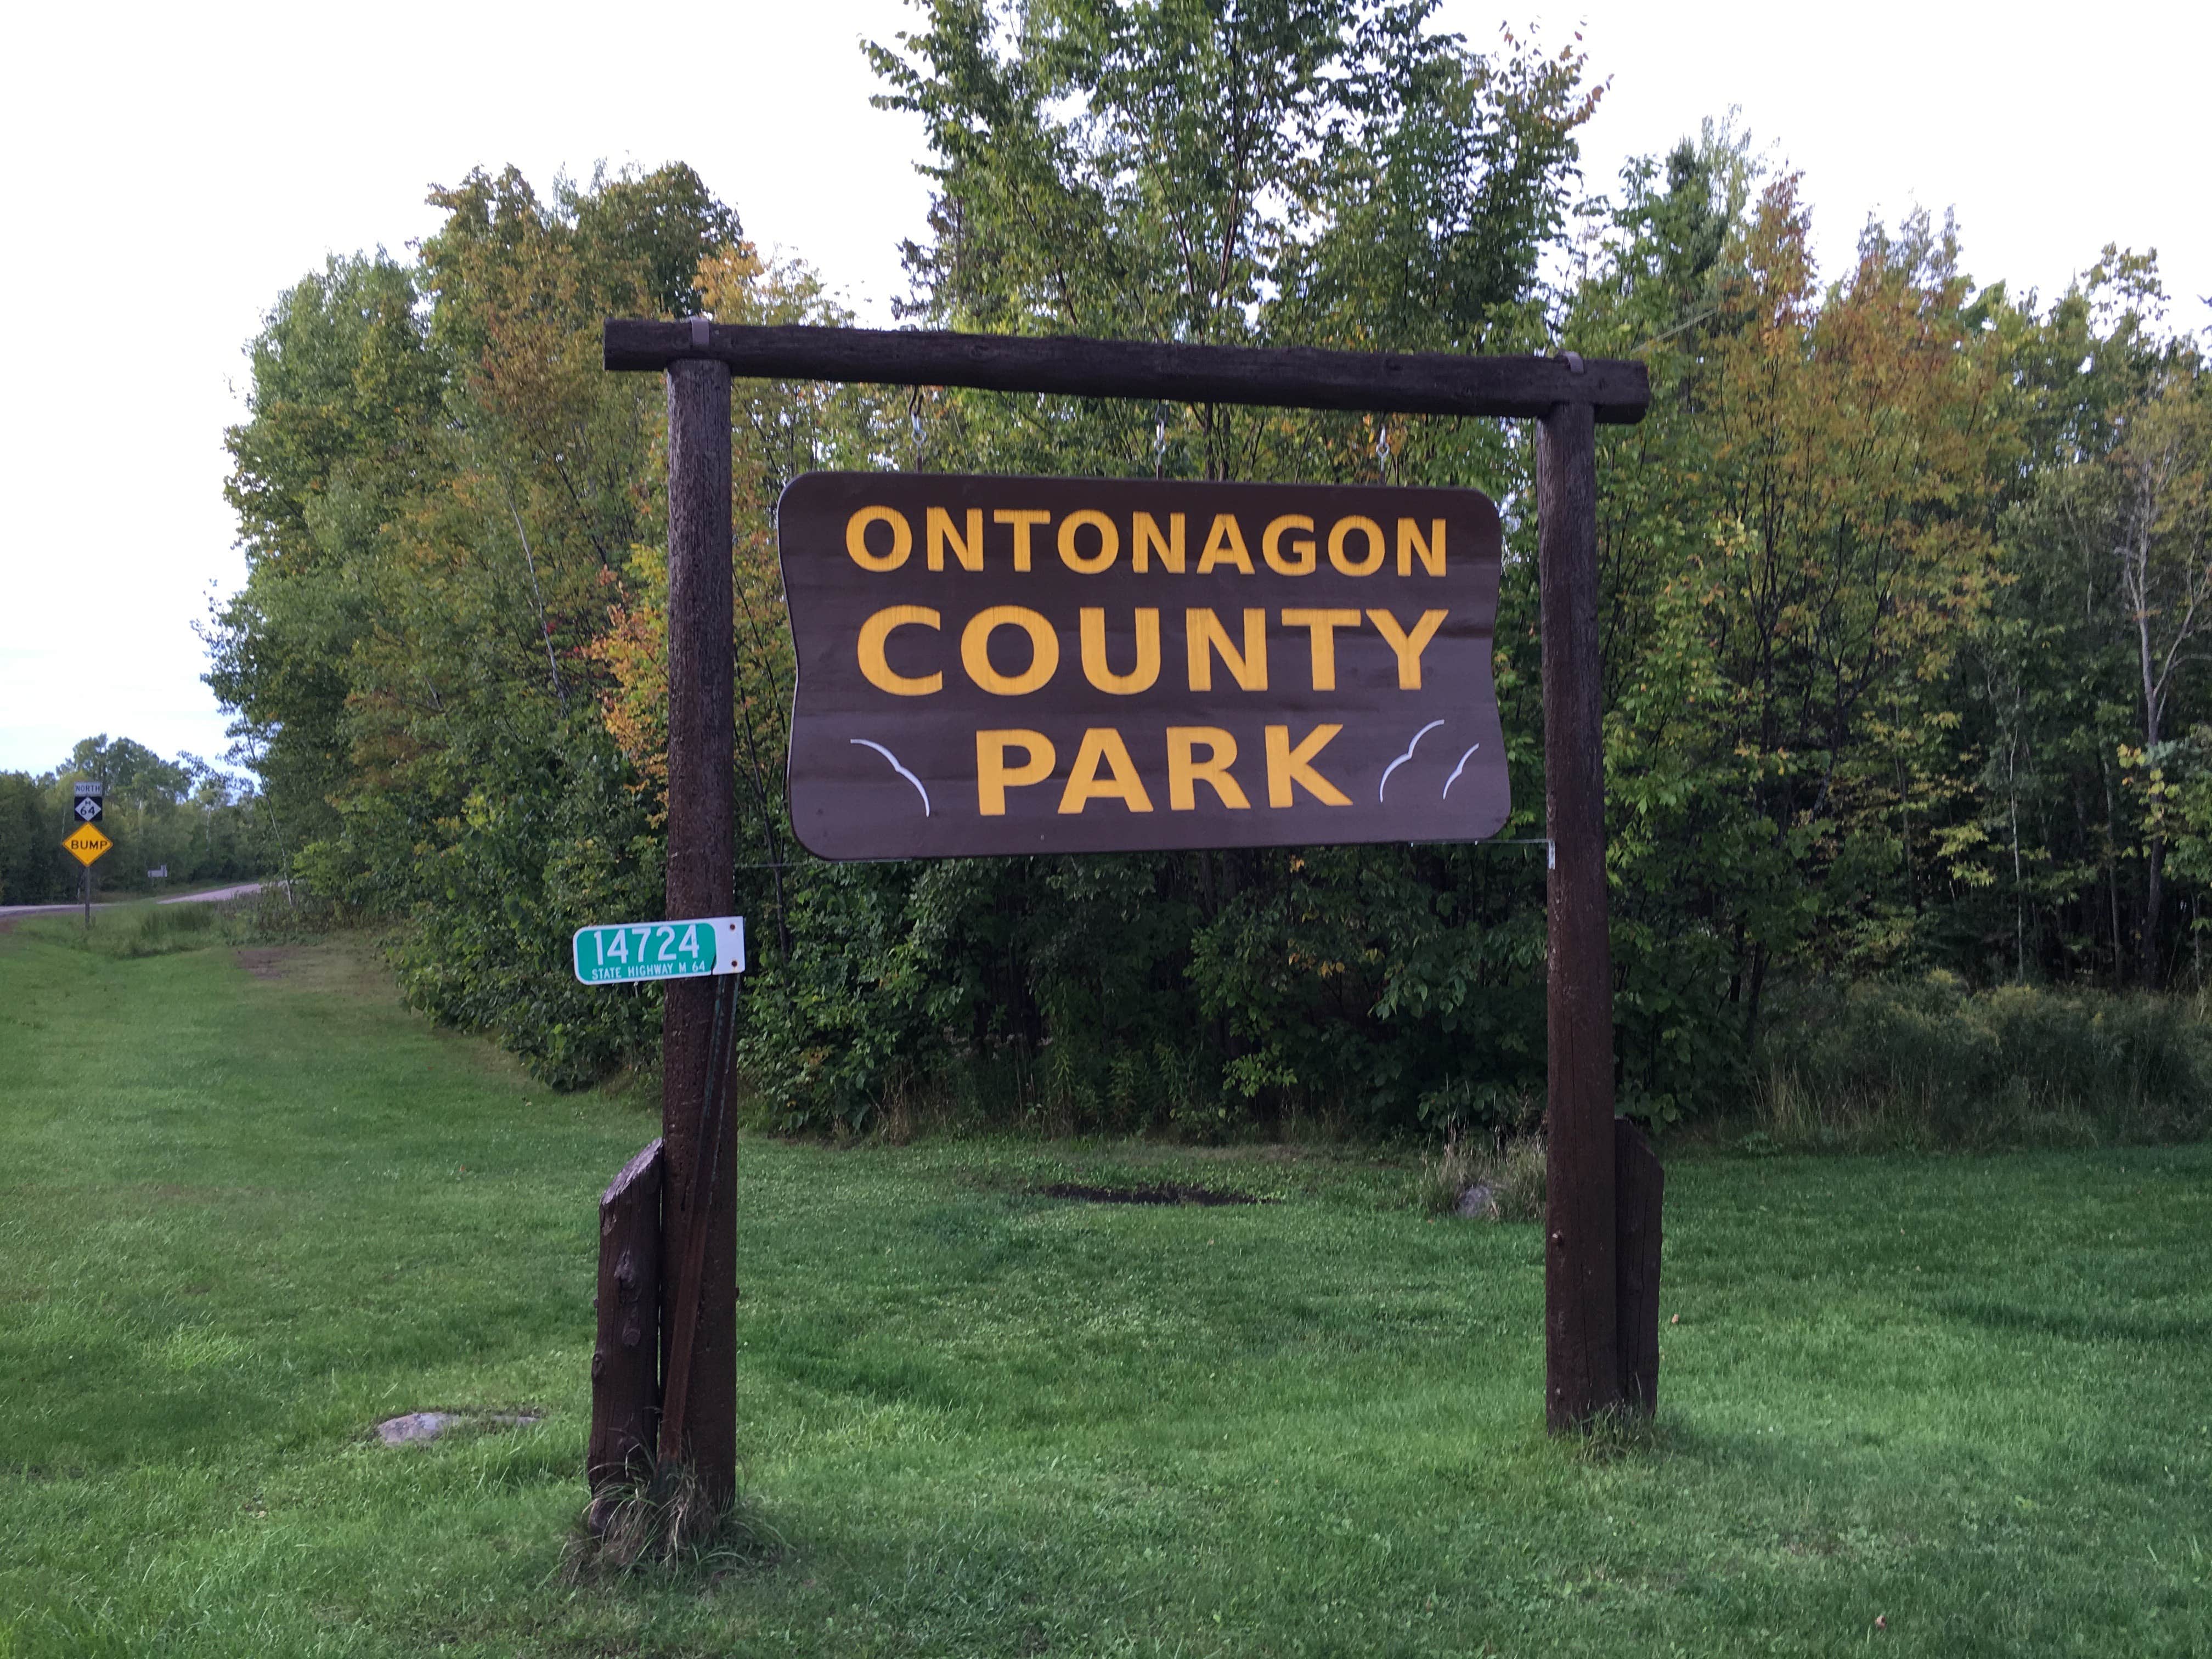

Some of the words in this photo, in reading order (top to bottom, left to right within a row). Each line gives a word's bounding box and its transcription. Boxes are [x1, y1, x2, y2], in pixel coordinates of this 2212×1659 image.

[846, 505, 1447, 577] ONTONAGON
[857, 605, 1449, 696] COUNTY
[975, 724, 1353, 816] PARK
[80, 806, 95, 815] 64
[71, 840, 108, 849] BUMP
[594, 924, 699, 966] 14724
[592, 967, 621, 979] STATE
[628, 963, 673, 977] HIGHWAY
[679, 962, 686, 972] M
[692, 961, 706, 972] 64
